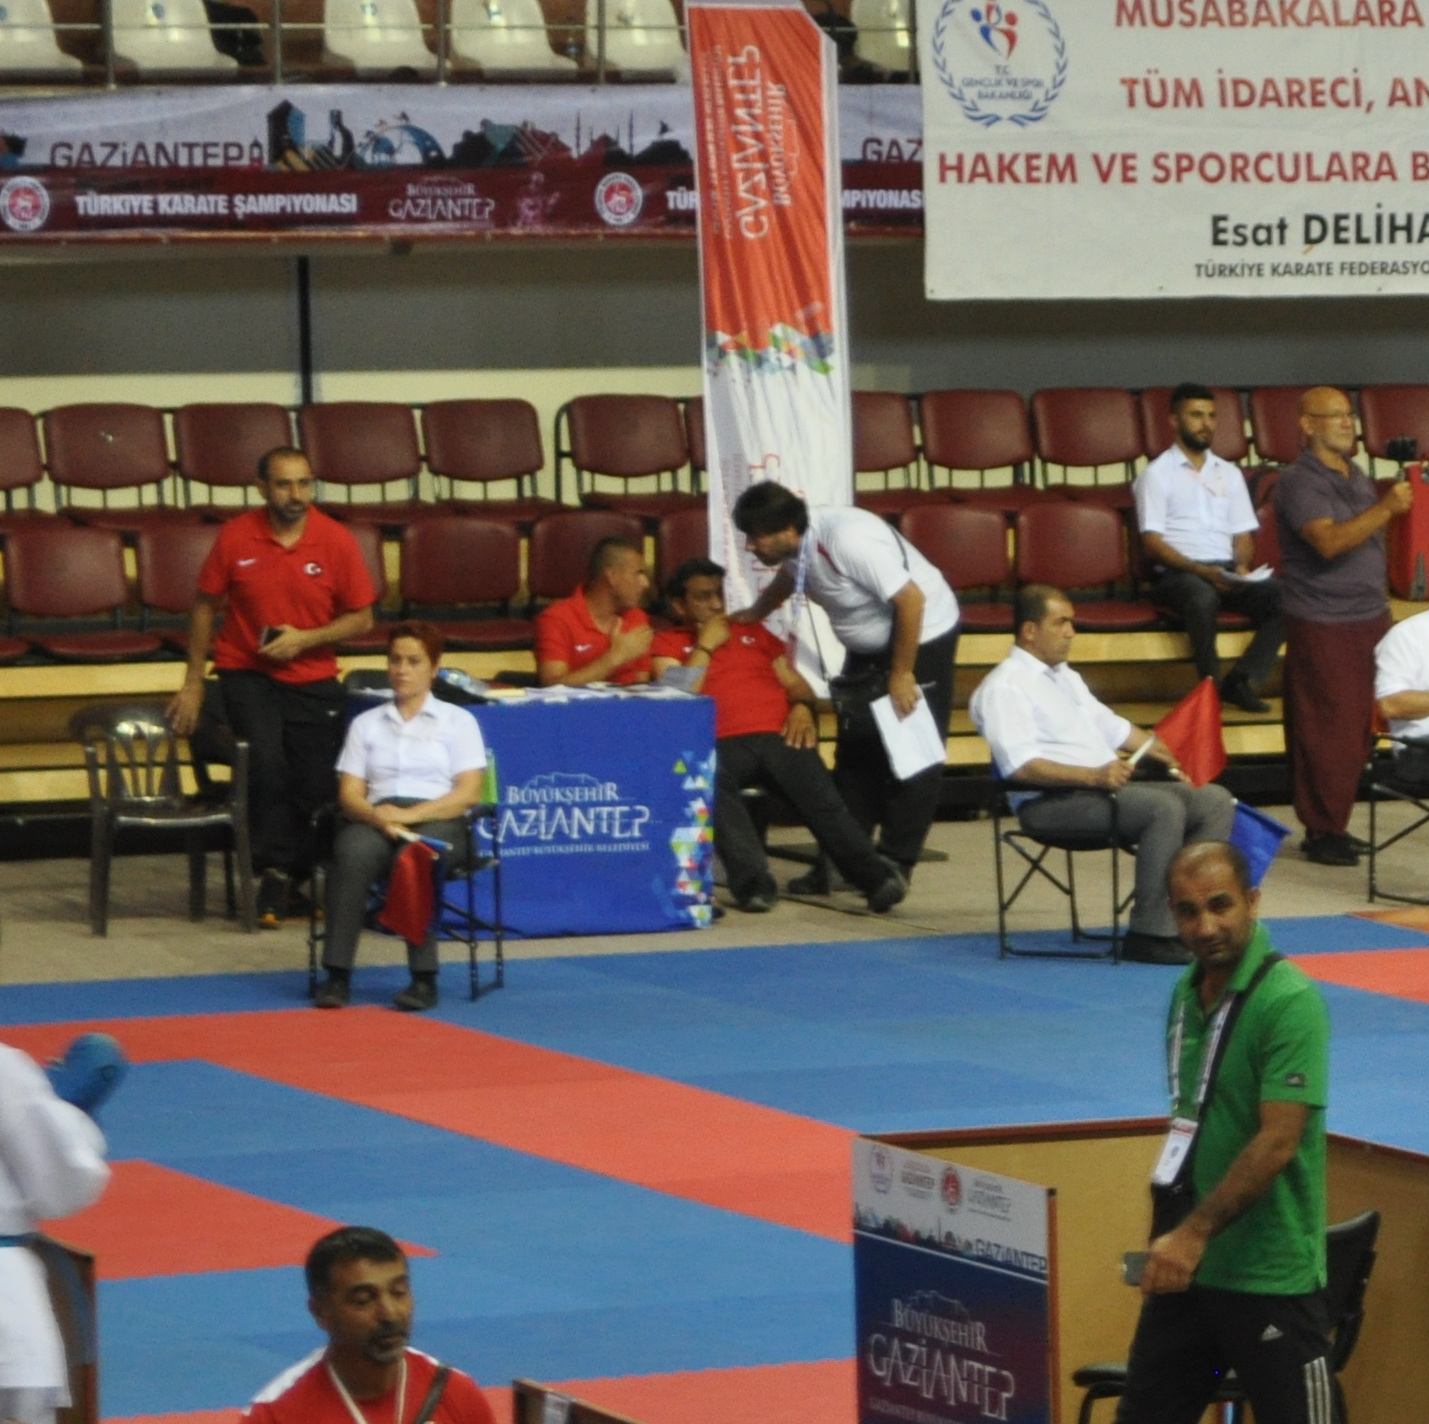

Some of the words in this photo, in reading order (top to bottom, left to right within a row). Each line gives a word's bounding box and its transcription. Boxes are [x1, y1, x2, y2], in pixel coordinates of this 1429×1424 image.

[1120, 69, 1204, 109] TÜM
[1218, 67, 1375, 114] İDARECİ,
[937, 152, 1078, 184] HAKEM
[1092, 152, 1138, 183] VE
[1152, 151, 1398, 183] SPORCULARA
[158, 193, 229, 215] KARATE
[1211, 214, 1289, 246] Esat
[1195, 260, 1266, 279] TÜRKİYE
[1271, 261, 1335, 277] KARATE
